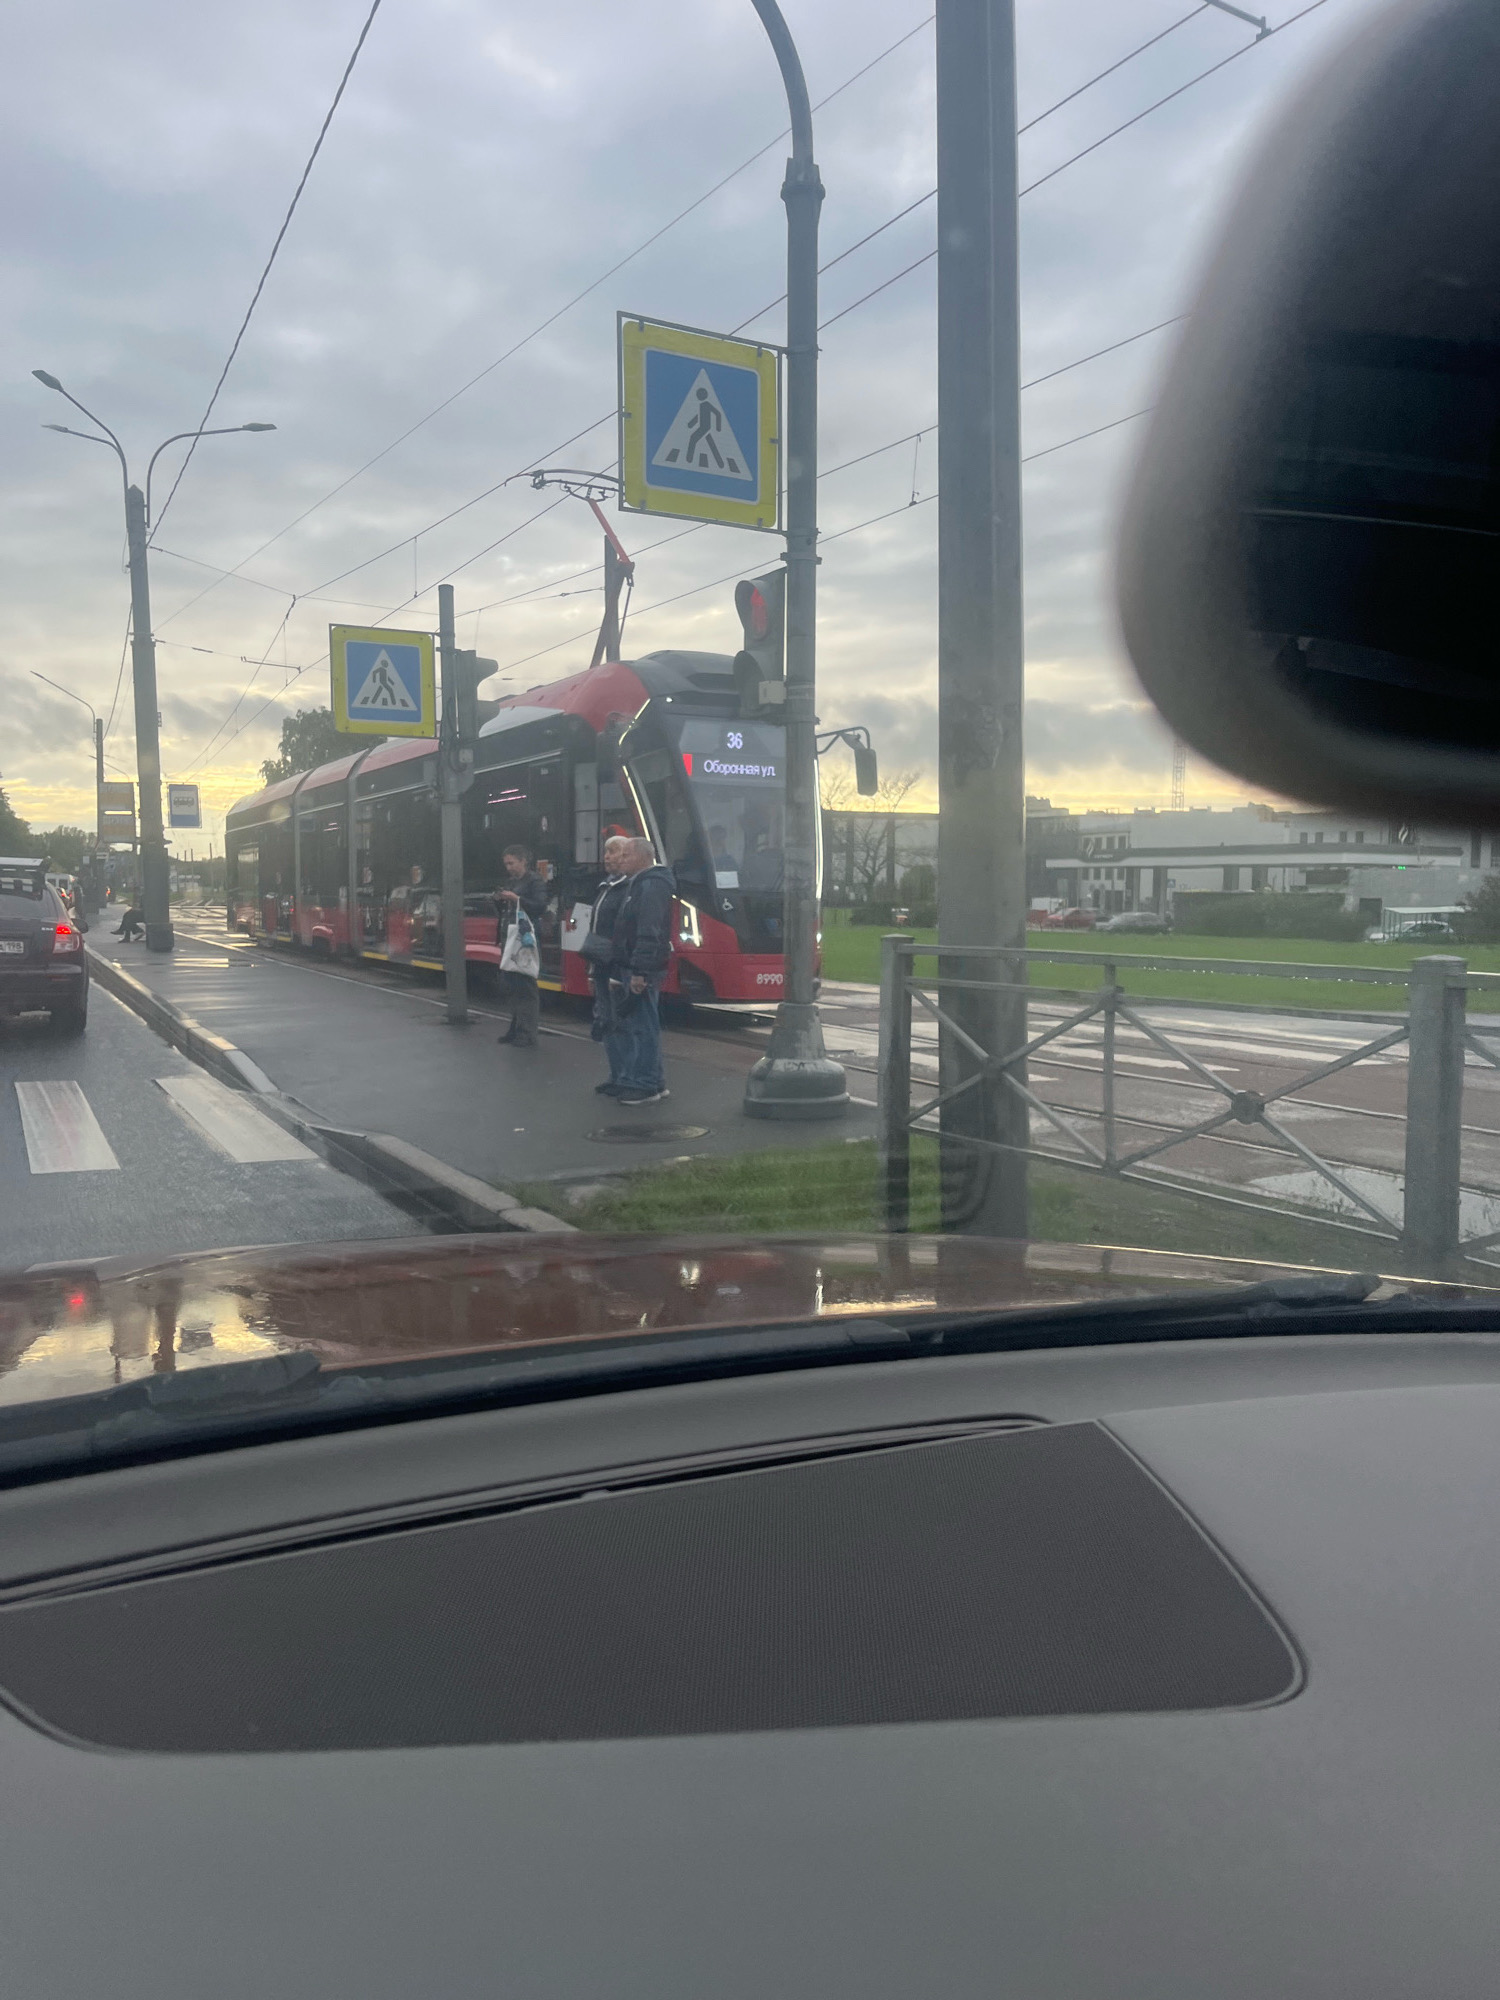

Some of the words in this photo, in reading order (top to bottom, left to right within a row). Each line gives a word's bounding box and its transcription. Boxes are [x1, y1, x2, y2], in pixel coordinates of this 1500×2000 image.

[726, 732, 743, 750] 36
[703, 759, 760, 775] Оборонная
[756, 973, 784, 985] 8990
